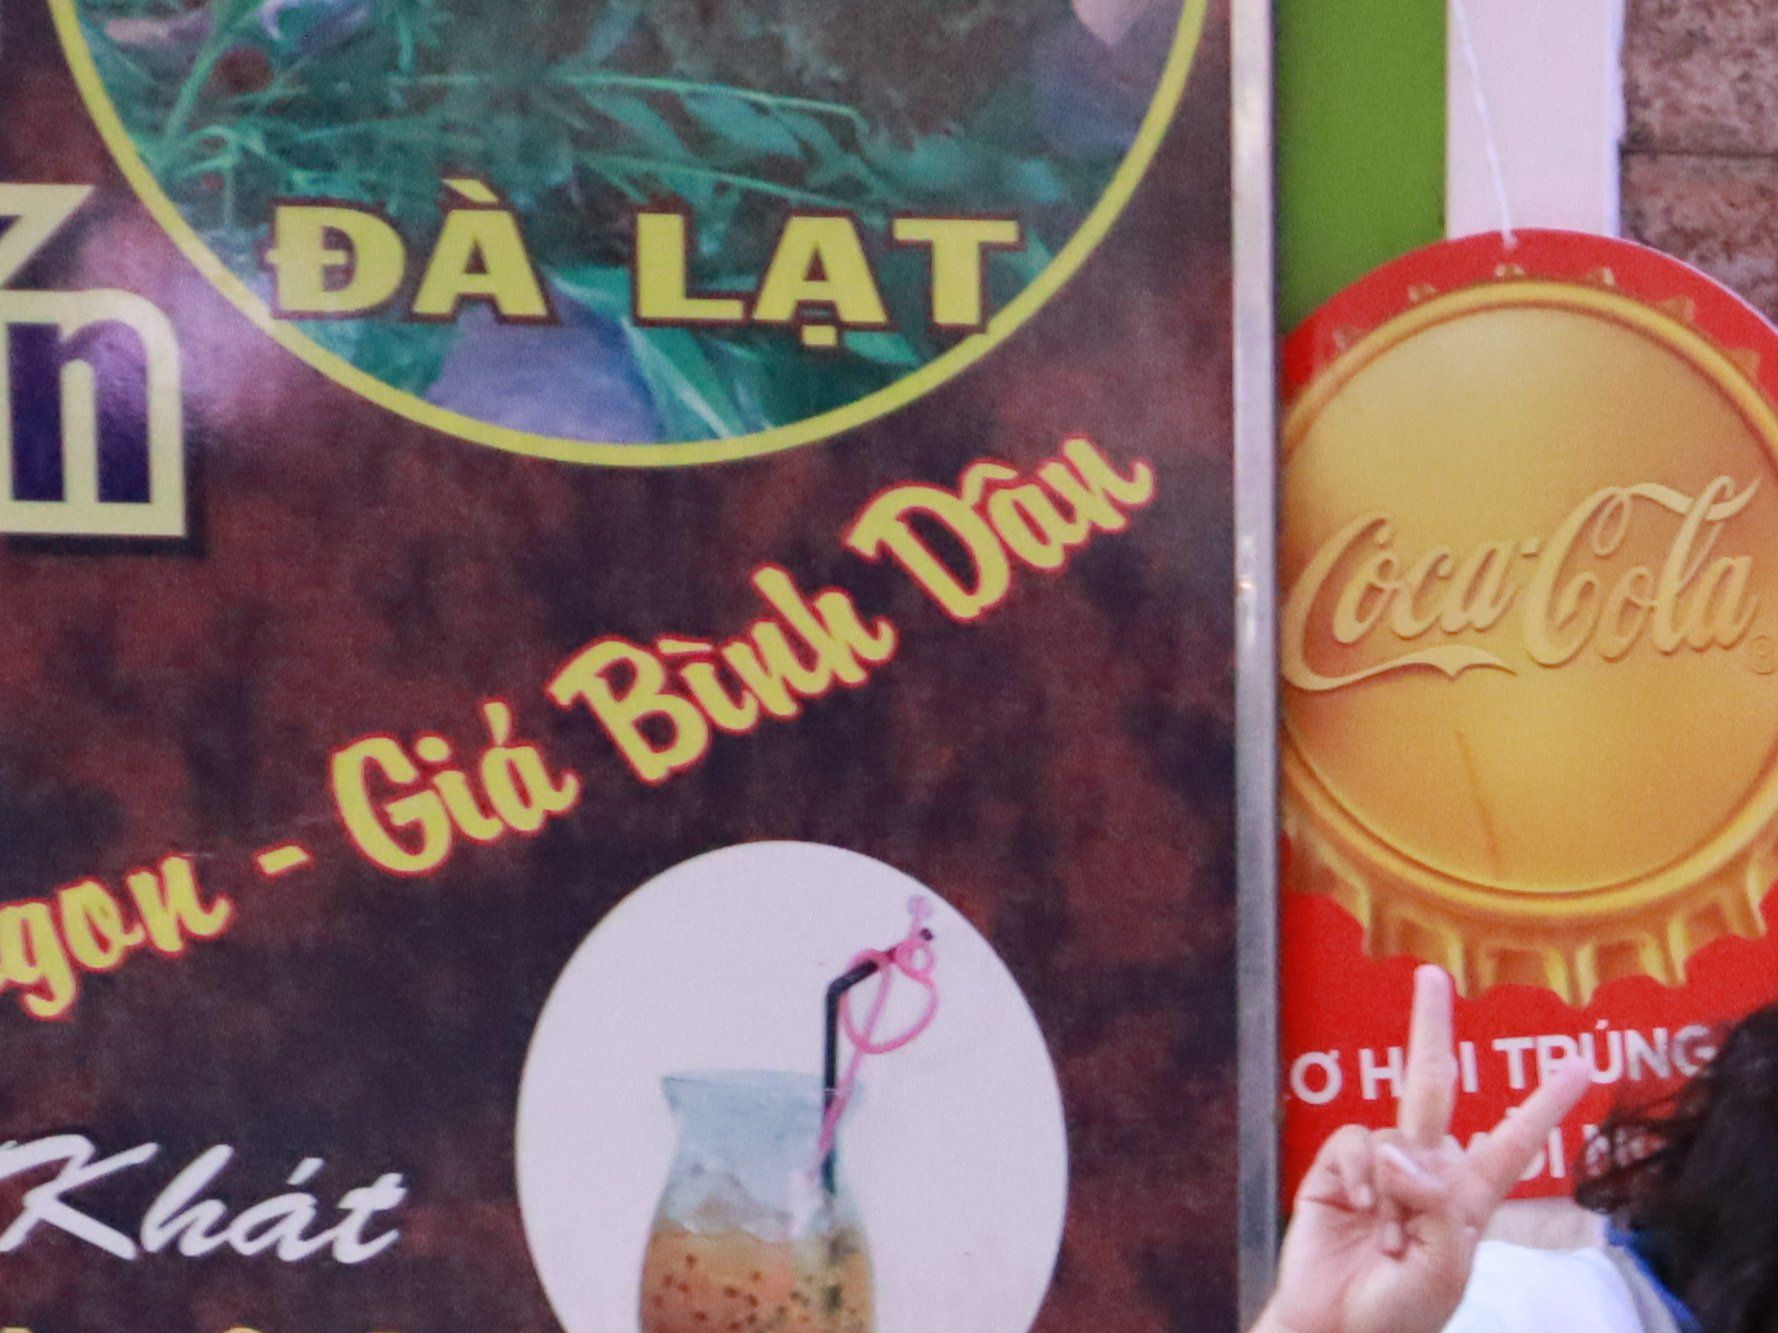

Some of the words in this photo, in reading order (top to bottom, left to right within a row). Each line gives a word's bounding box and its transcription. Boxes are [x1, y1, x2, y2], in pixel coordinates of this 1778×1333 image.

[265, 179, 551, 322] ĐÀ
[632, 209, 1019, 348] LẠT
[332, 702, 579, 873] Giá
[552, 567, 895, 784] Bình
[848, 437, 1155, 621] Dân
[1283, 475, 1763, 690] Coca-Cola
[1358, 1040, 1479, 1101] HI
[0, 1133, 408, 1265] Khát
